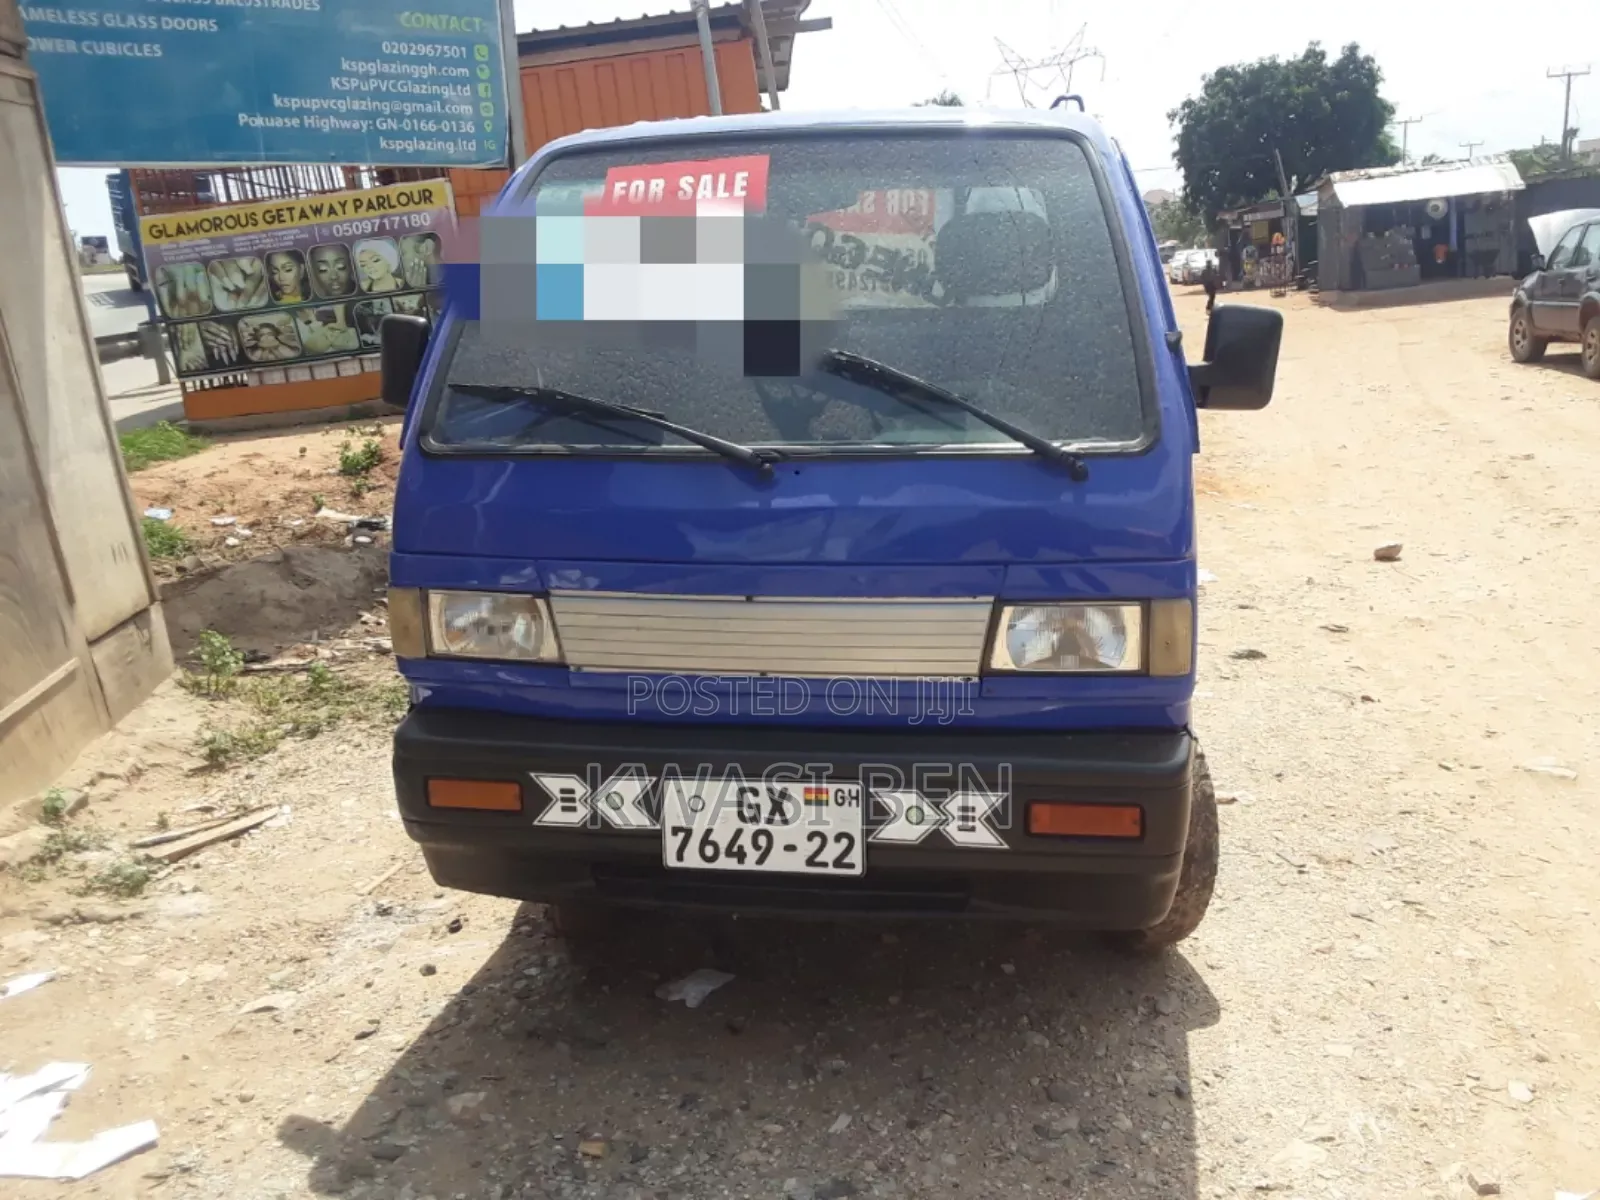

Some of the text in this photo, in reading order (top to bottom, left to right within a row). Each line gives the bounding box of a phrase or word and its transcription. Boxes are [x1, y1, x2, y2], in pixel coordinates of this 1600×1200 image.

[103, 13, 158, 29] GLASS
[160, 16, 219, 32] DOORS
[81, 40, 163, 57] CUBICLES
[381, 40, 468, 59] 0202967501
[340, 57, 470, 79] kspglazinggh.com
[330, 76, 472, 97] KSPuPVCGlazingLtd
[272, 93, 474, 116] kspupvcglazing@gmail.com
[237, 113, 476, 134] Pokuase Highway: GN-0166-0136
[379, 135, 477, 154] kspglazing.ltd
[611, 171, 749, 205] FOR SALE
[149, 187, 434, 240] GLAMOROUS GETAWAY PARLOUR
[332, 212, 432, 238] 0509717180
[735, 786, 860, 826] GX GH
[671, 825, 858, 870] 7649-22
